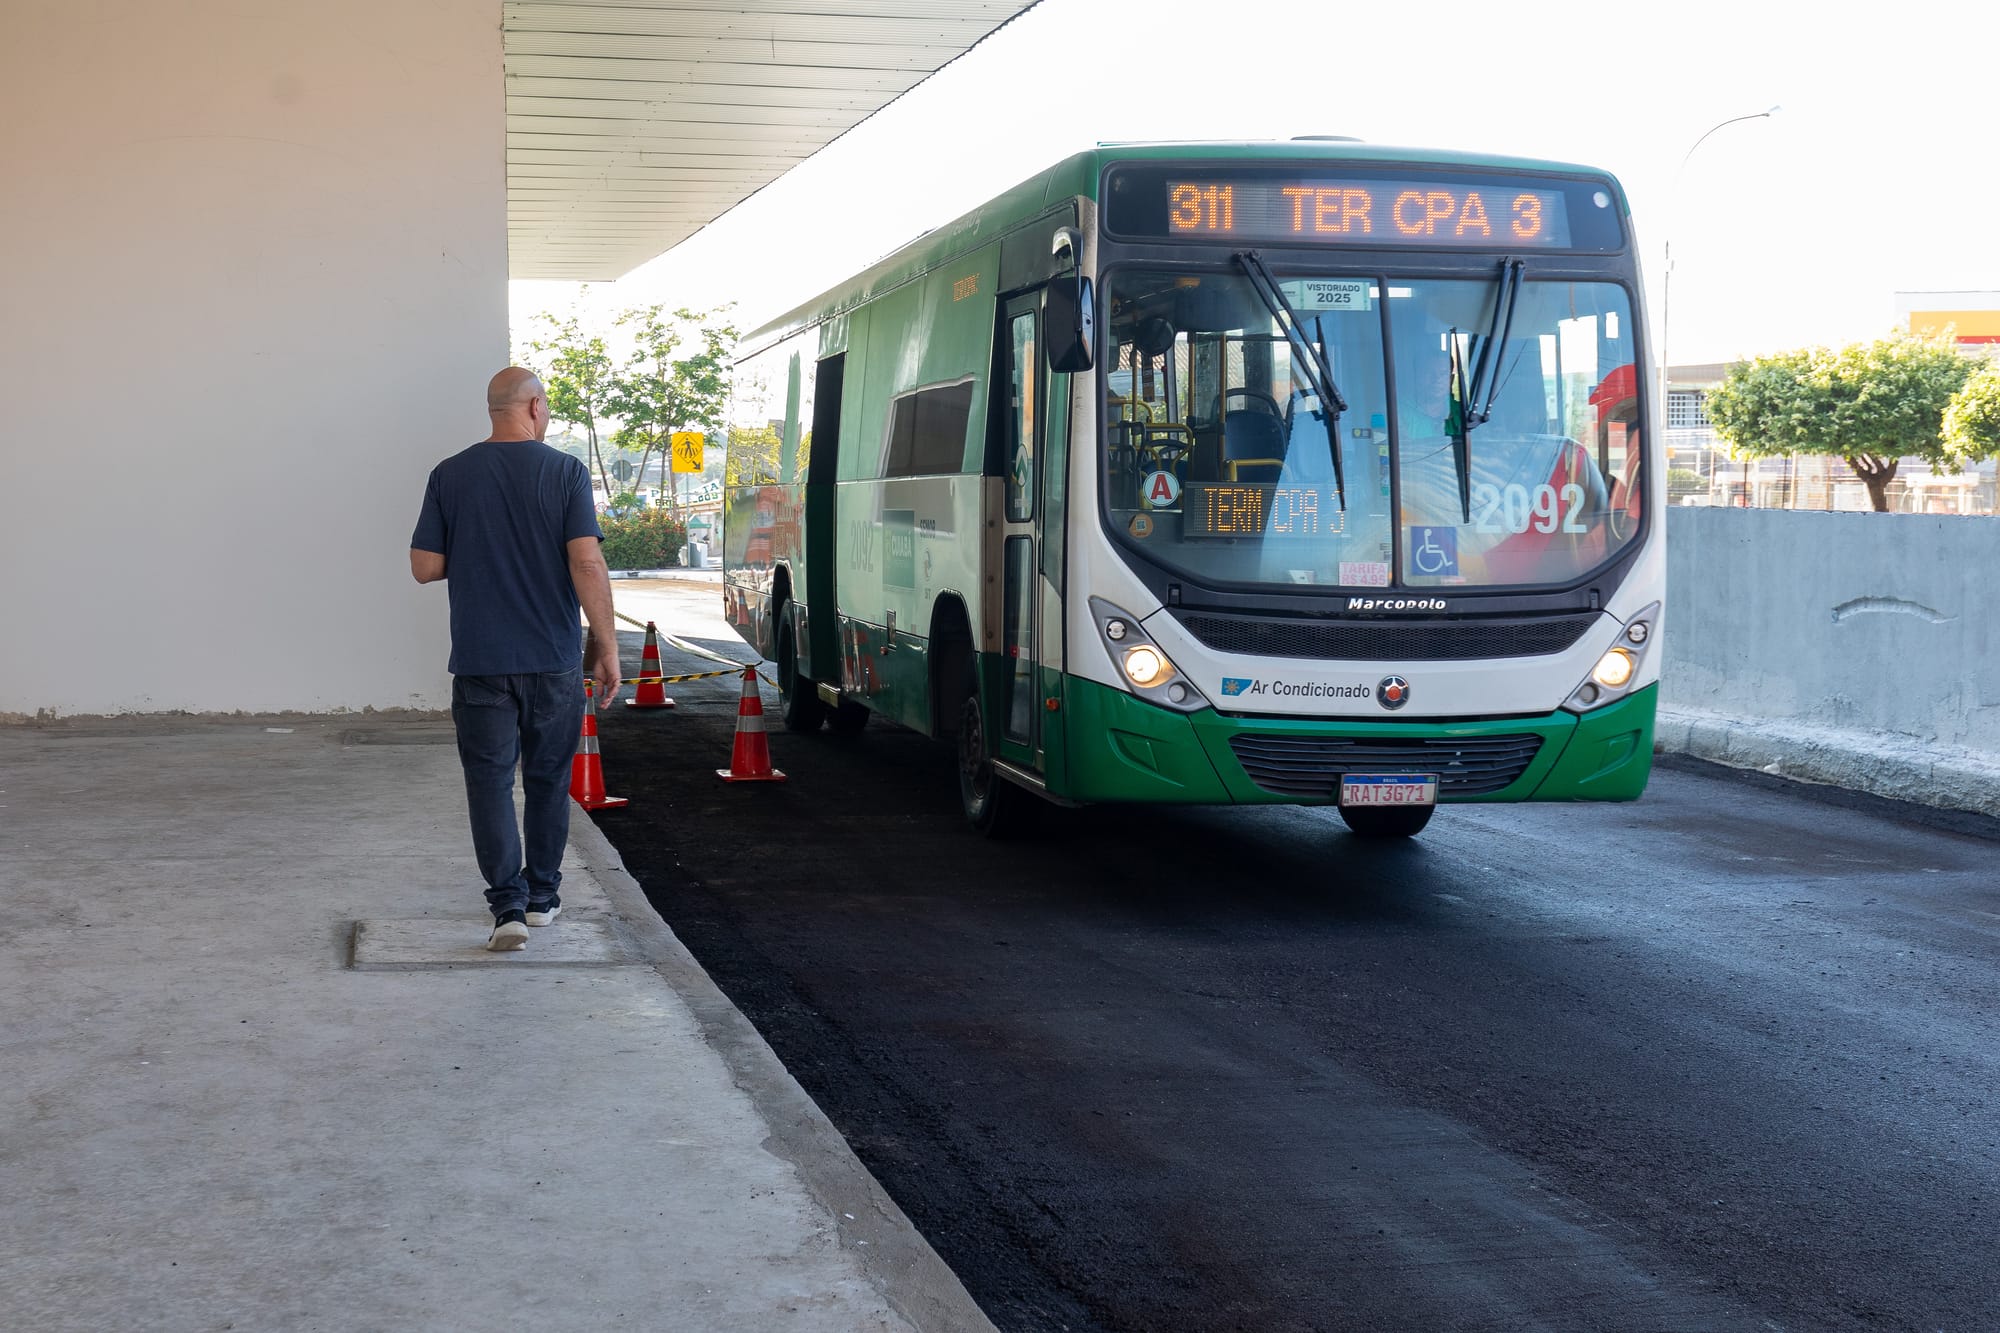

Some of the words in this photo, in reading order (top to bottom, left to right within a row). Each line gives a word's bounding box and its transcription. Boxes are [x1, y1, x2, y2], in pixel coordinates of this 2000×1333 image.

[1171, 184, 1233, 231] 311
[1283, 186, 1372, 233] TER
[1393, 190, 1491, 237] CPA
[1512, 193, 1542, 238] 3
[1307, 283, 1360, 292] VISTORIADO
[1317, 293, 1351, 303] 2025
[1150, 474, 1172, 499] A
[1204, 488, 1262, 532] TERM
[1274, 489, 1318, 533] CPA
[1475, 483, 1587, 534] 2092
[851, 520, 874, 573] 2092
[1341, 562, 1386, 574] TARIFA
[1348, 598, 1447, 611] Marcopolo
[1250, 679, 1269, 695] Ar
[1272, 680, 1370, 698] Condicionado
[1349, 785, 1425, 802] RAT3G71
